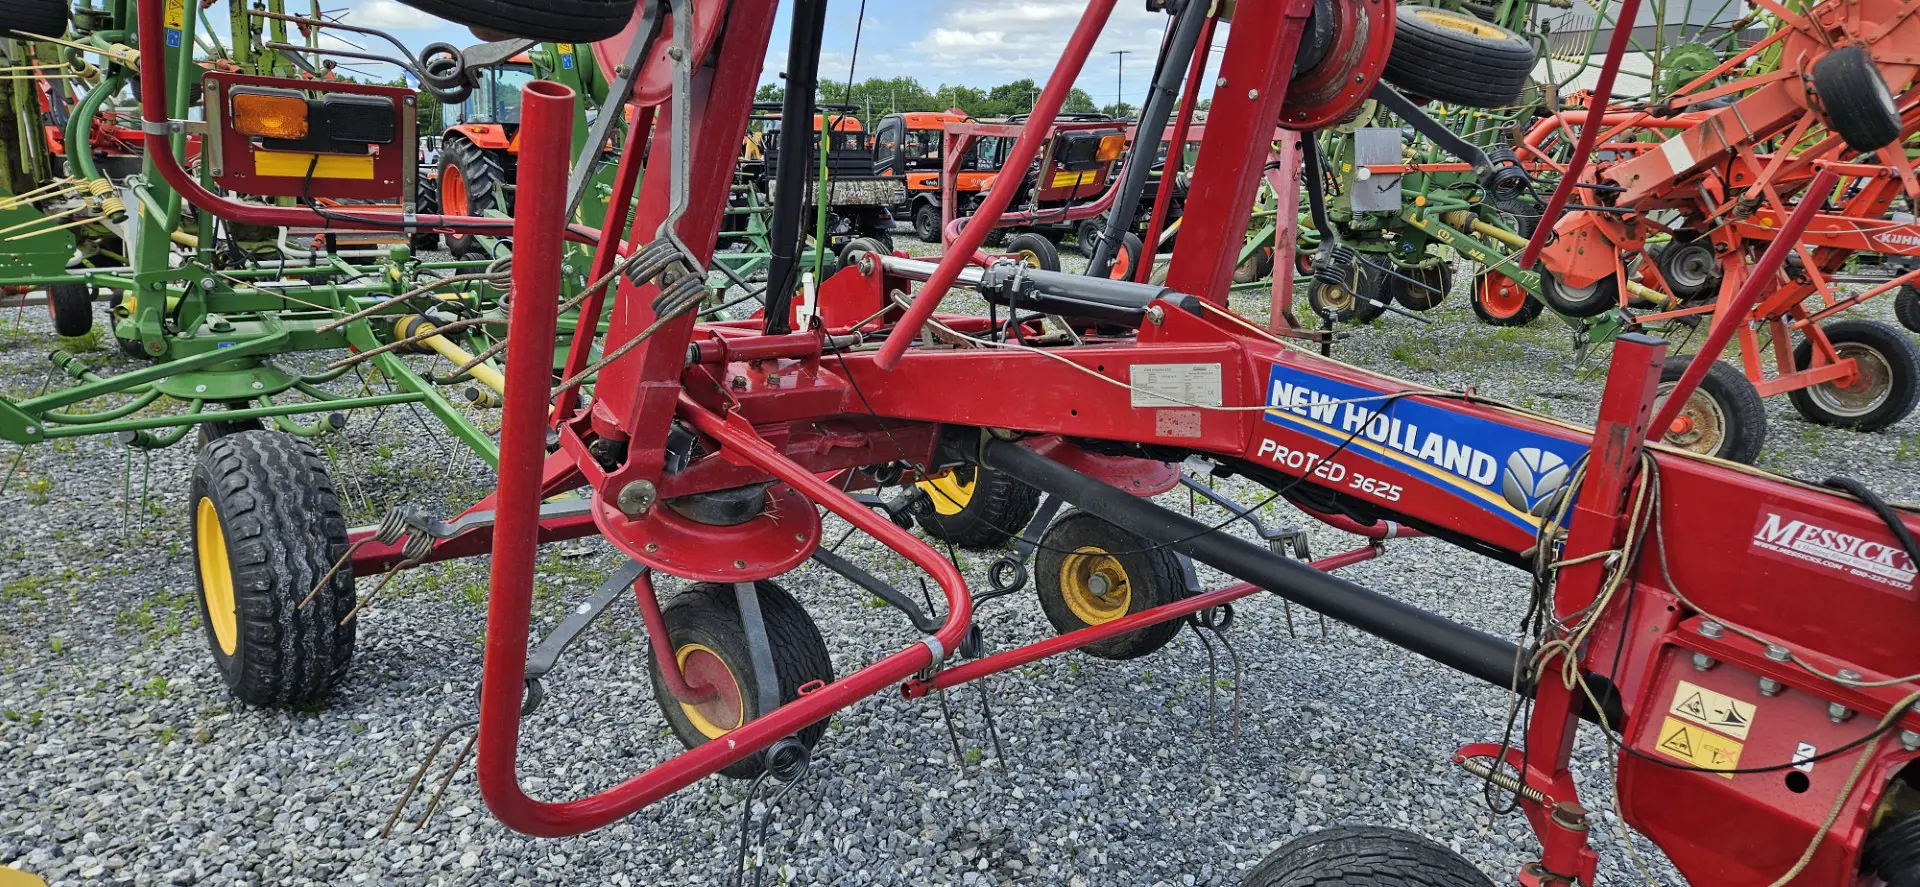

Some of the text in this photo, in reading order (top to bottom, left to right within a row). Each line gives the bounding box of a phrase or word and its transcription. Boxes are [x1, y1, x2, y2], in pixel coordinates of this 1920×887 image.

[1271, 379, 1498, 486] NEW HOLLAND
[1349, 472, 1403, 502] 3625
[1754, 513, 1919, 573] MESSICK'S
